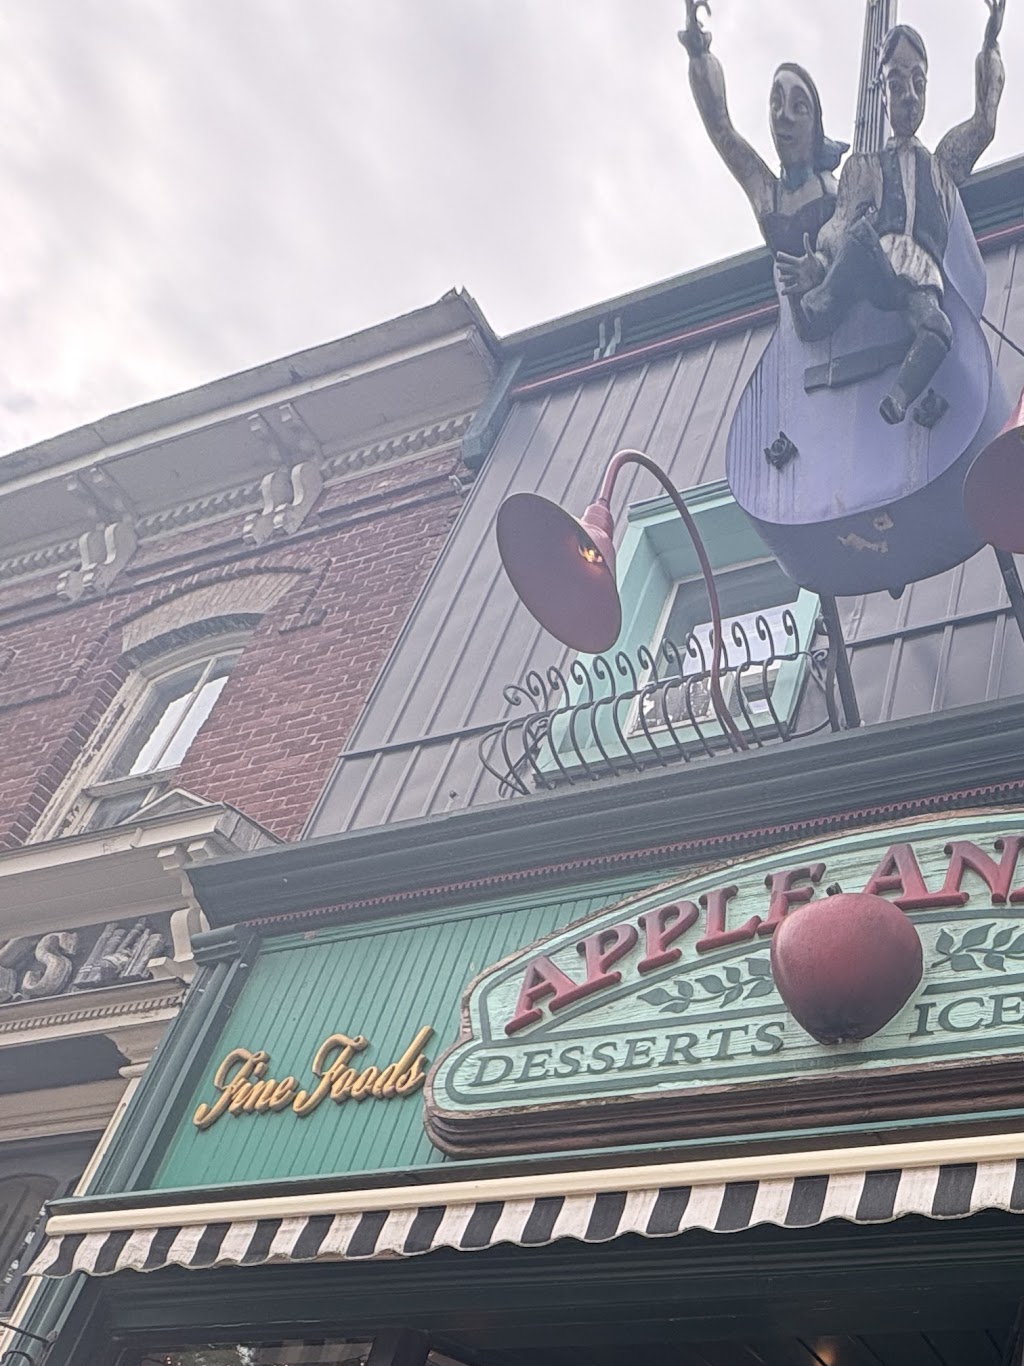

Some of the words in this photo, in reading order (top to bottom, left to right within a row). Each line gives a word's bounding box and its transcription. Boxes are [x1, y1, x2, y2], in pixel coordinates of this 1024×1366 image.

[504, 861, 827, 1036] APPLE
[193, 1047, 299, 1130] Fine
[293, 1025, 435, 1117] Foods
[468, 1020, 786, 1088] DESSERTS
